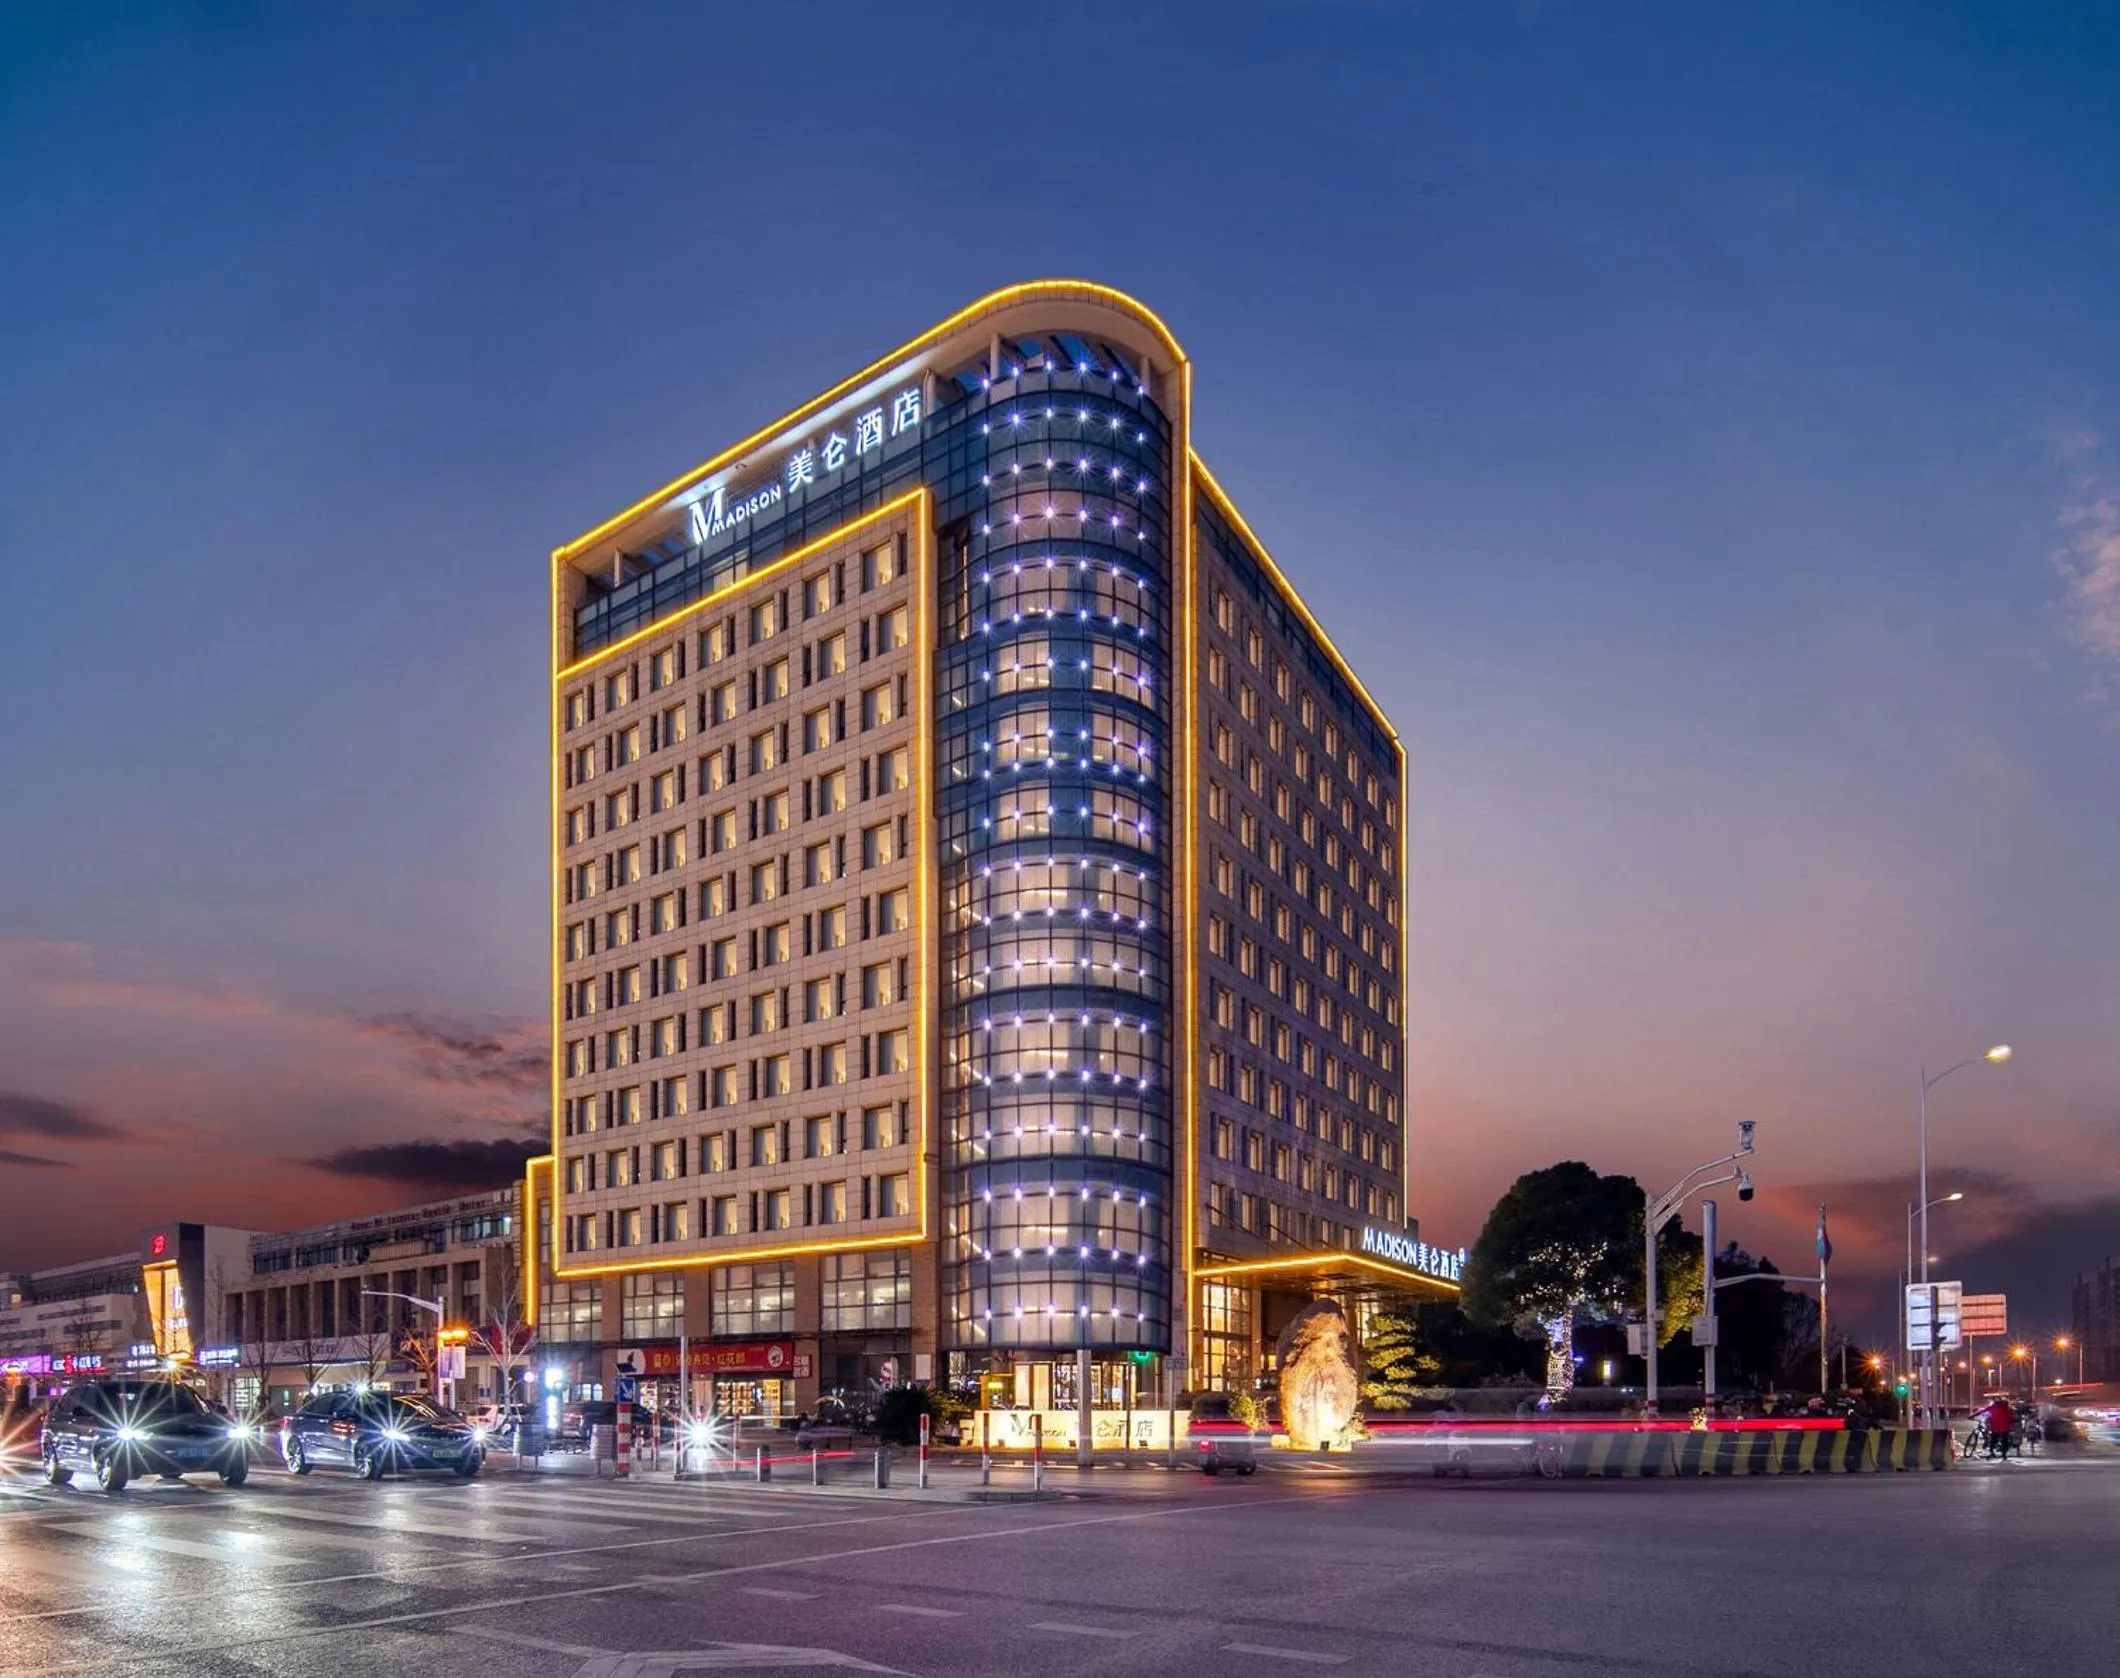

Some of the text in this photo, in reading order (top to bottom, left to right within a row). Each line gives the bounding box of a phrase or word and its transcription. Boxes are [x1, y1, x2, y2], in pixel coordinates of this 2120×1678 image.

[711, 485, 781, 536] MADISON
[788, 387, 920, 493] 美仑酒店
[1362, 1225, 1418, 1266] MADISON
[1418, 1241, 1460, 1281] 美仑酒店
